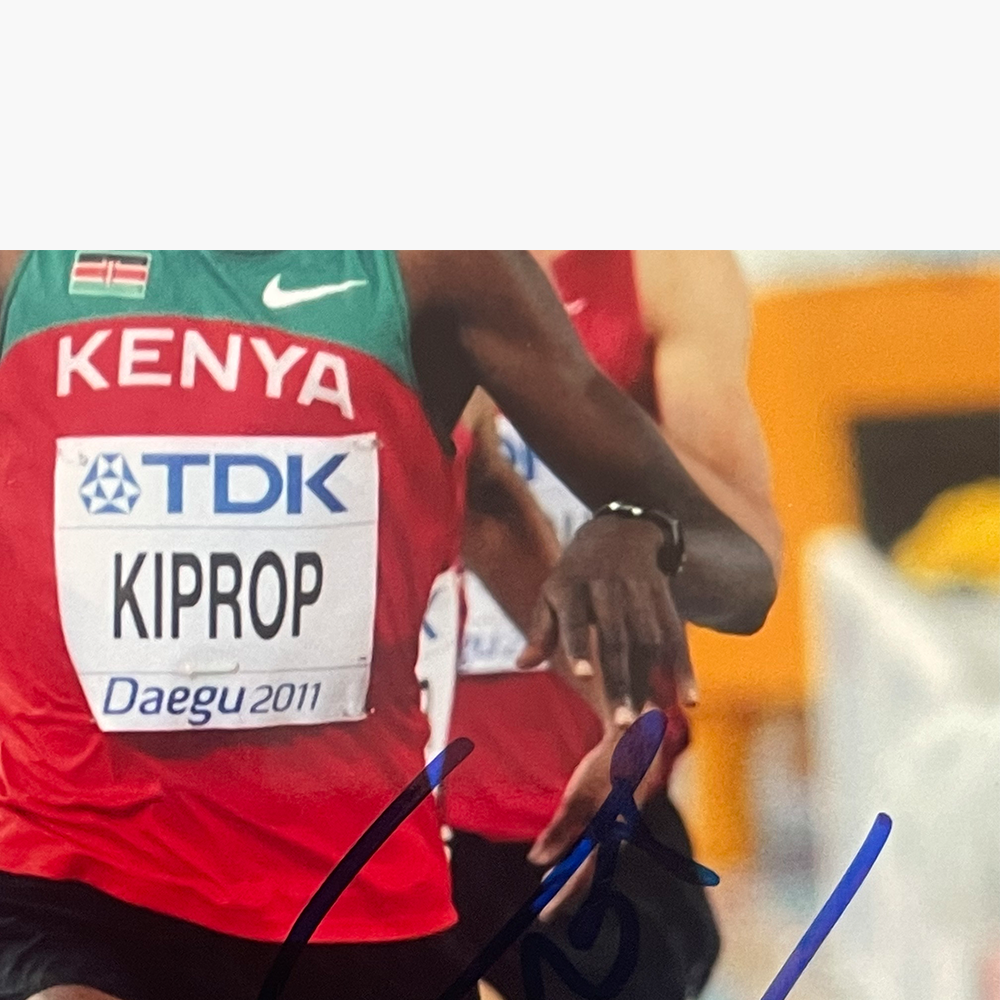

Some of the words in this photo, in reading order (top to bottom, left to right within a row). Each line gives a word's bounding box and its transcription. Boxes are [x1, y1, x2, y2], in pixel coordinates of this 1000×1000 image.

[56, 327, 355, 420] KENYA
[141, 452, 349, 515] TDK
[112, 550, 324, 640] KIPROP
[102, 676, 246, 726] Daegu
[249, 681, 322, 713] 2011
